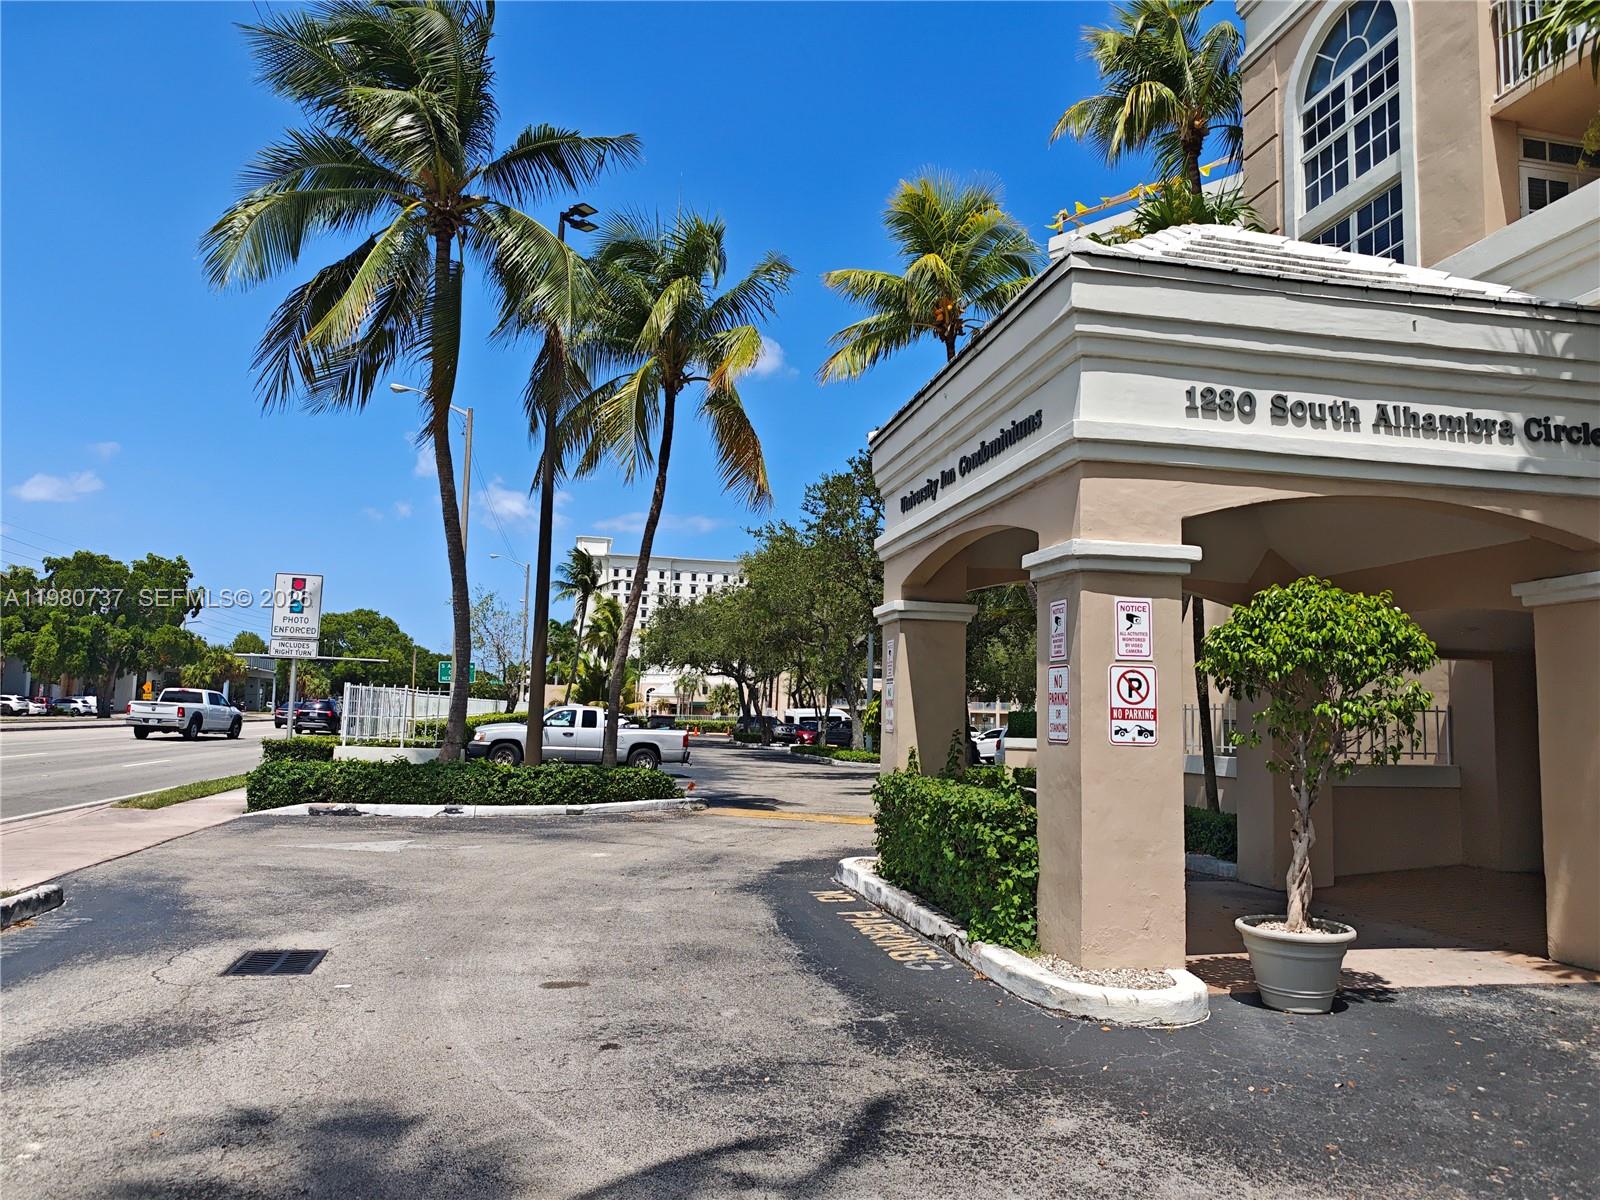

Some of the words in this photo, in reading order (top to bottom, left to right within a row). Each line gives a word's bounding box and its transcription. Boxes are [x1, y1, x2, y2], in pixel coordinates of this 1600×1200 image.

[1185, 386, 1257, 416] 1230
[1270, 393, 1361, 424] South
[1372, 403, 1515, 438] Alhambra
[1523, 416, 1600, 446] Circle
[900, 478, 939, 514] University
[940, 467, 956, 490] Inn
[958, 409, 1043, 478] Condominiums
[282, 615, 310, 625] PHOTO
[273, 625, 317, 635] ENFORCED
[278, 641, 310, 649] INCLUDES
[274, 648, 293, 656] RIGHT
[295, 649, 312, 657] TURN
[1054, 674, 1062, 689] NO
[1113, 708, 1123, 718] NO
[1125, 709, 1154, 720] PARKING
